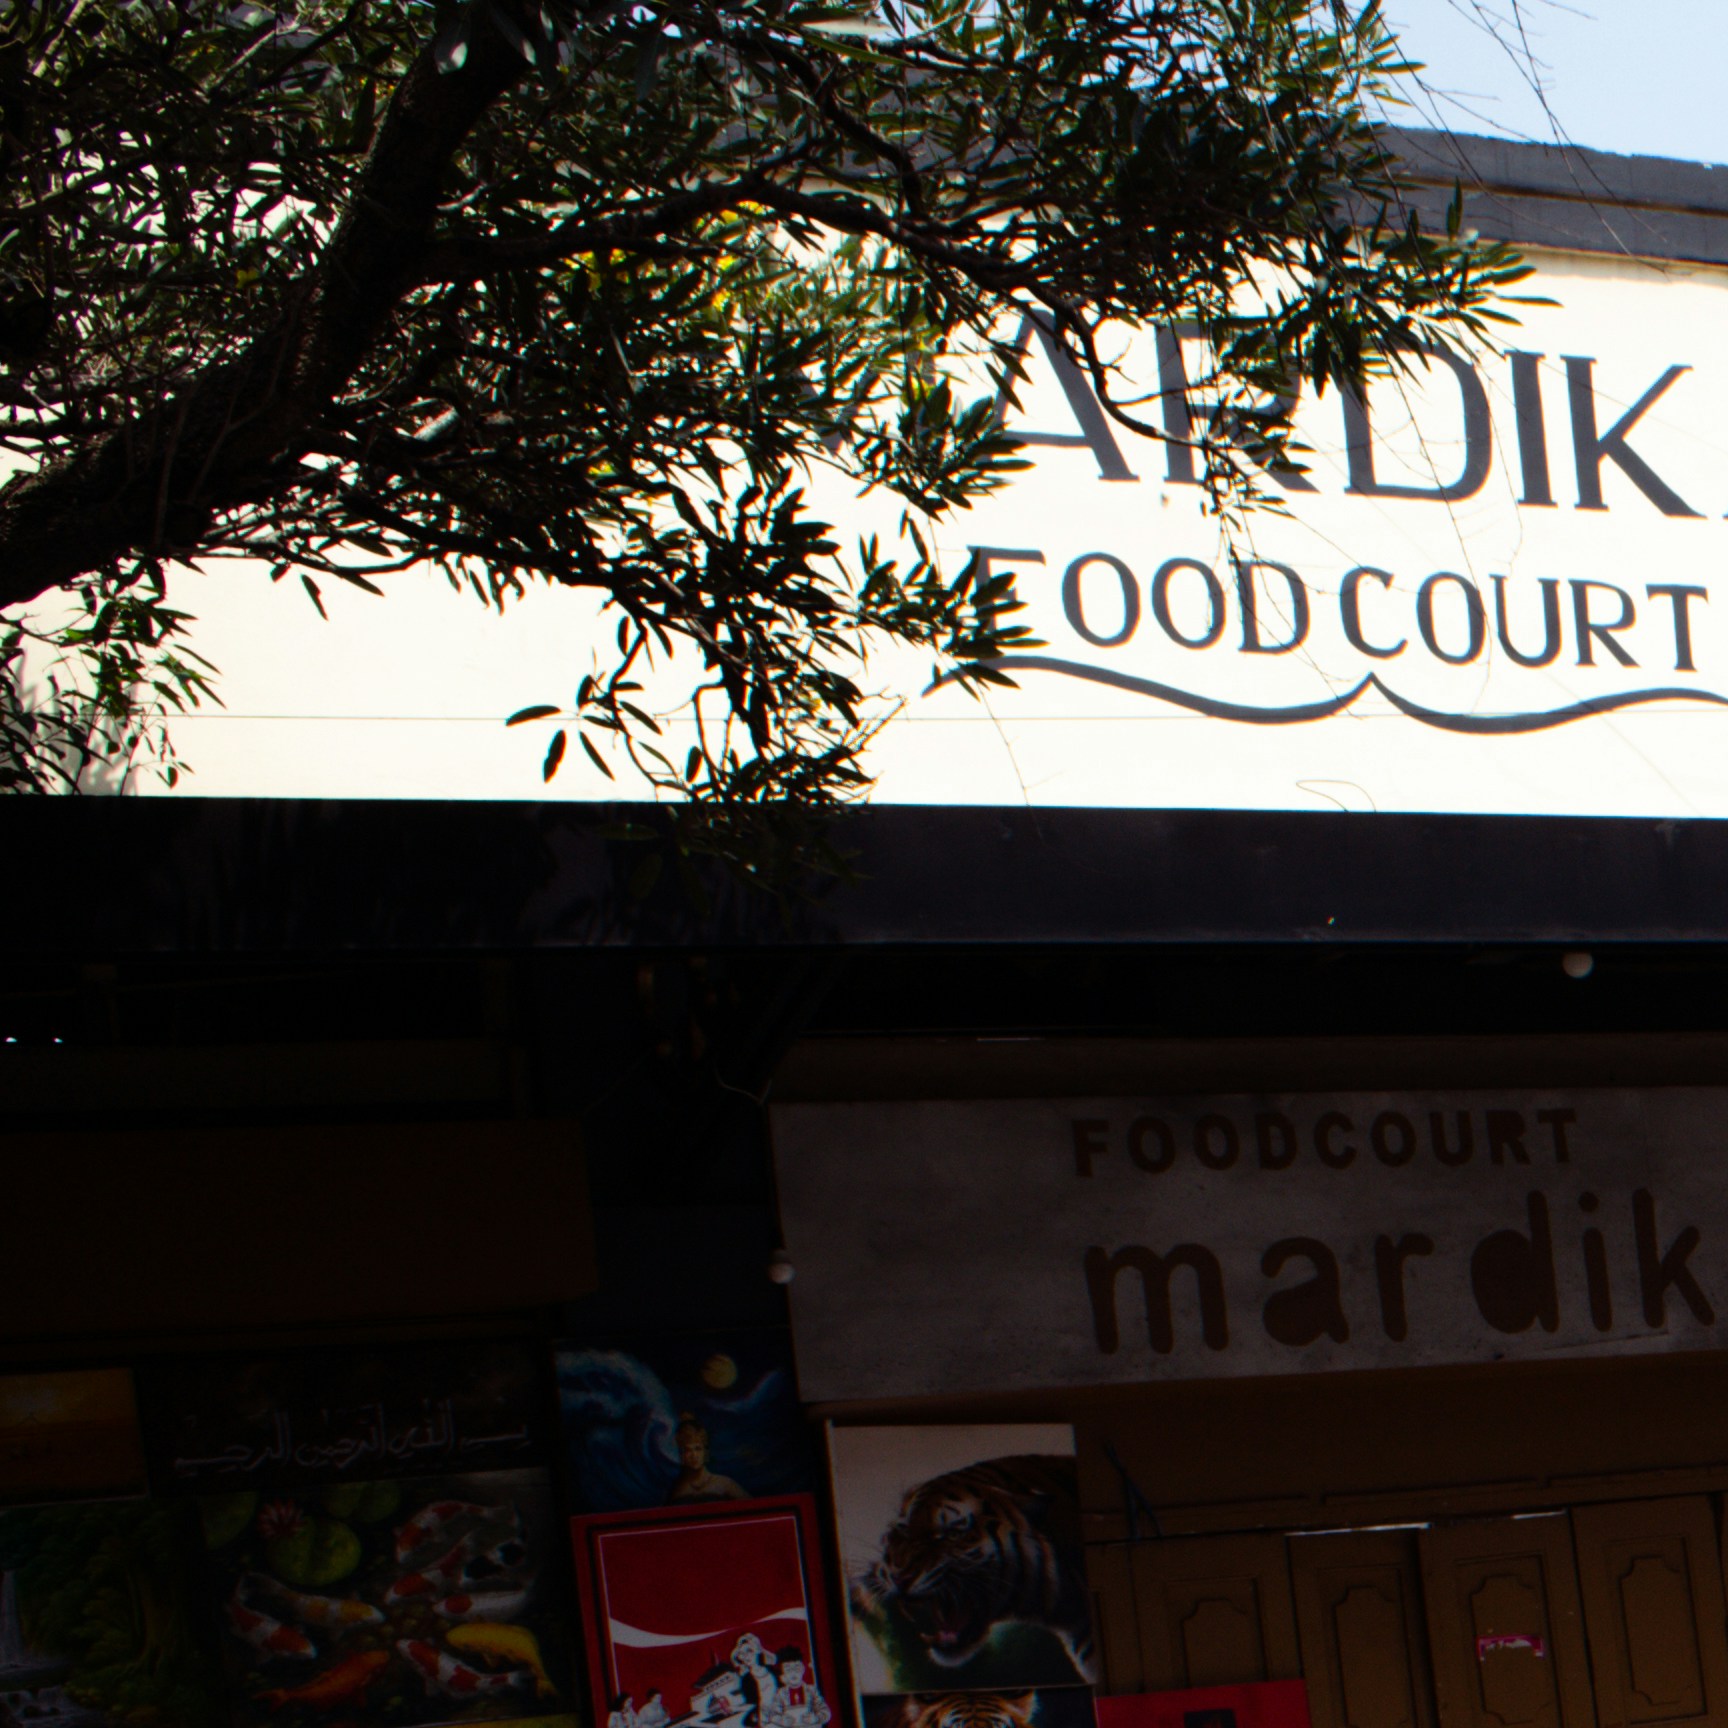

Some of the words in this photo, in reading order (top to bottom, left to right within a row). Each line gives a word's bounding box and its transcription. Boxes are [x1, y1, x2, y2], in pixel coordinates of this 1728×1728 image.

[966, 544, 1310, 655] FOOD
[1339, 565, 1710, 673] COURT
[1072, 1105, 1580, 1178] FOODCOURT
